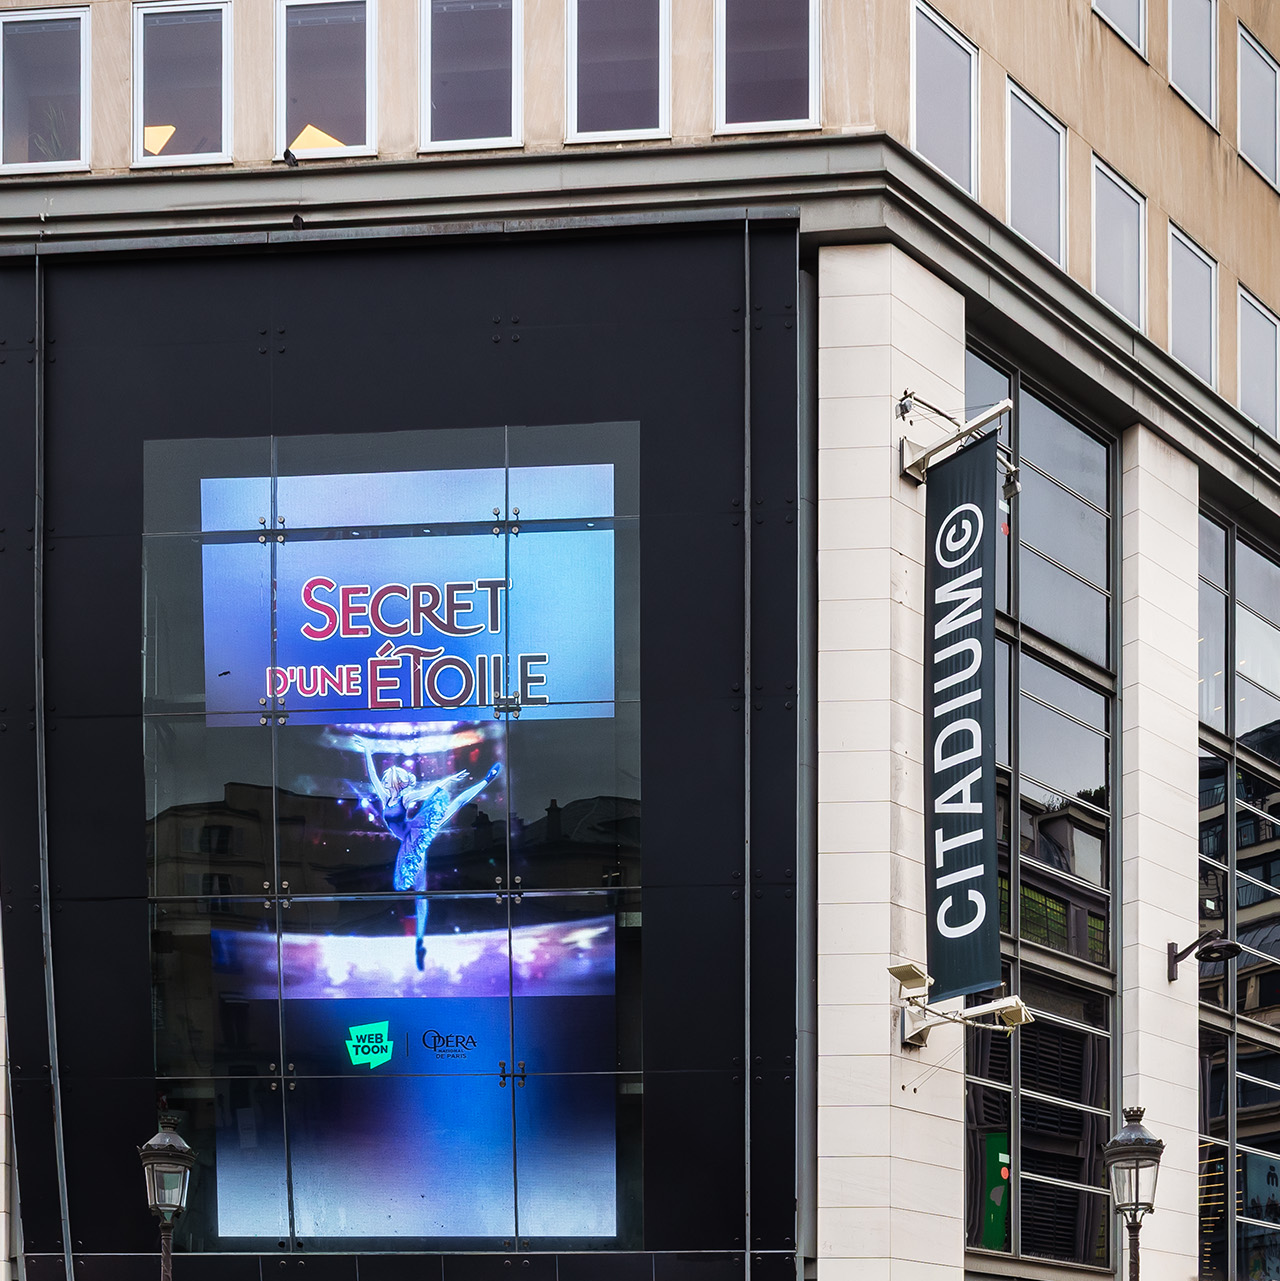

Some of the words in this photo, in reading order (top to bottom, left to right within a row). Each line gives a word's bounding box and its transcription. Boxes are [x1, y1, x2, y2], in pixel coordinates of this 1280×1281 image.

[301, 576, 512, 641] SECRET
[266, 665, 362, 698] D'UNE
[367, 640, 549, 710] ÉTOILE
[353, 1044, 388, 1056] TOON
[356, 1033, 384, 1044] WEB
